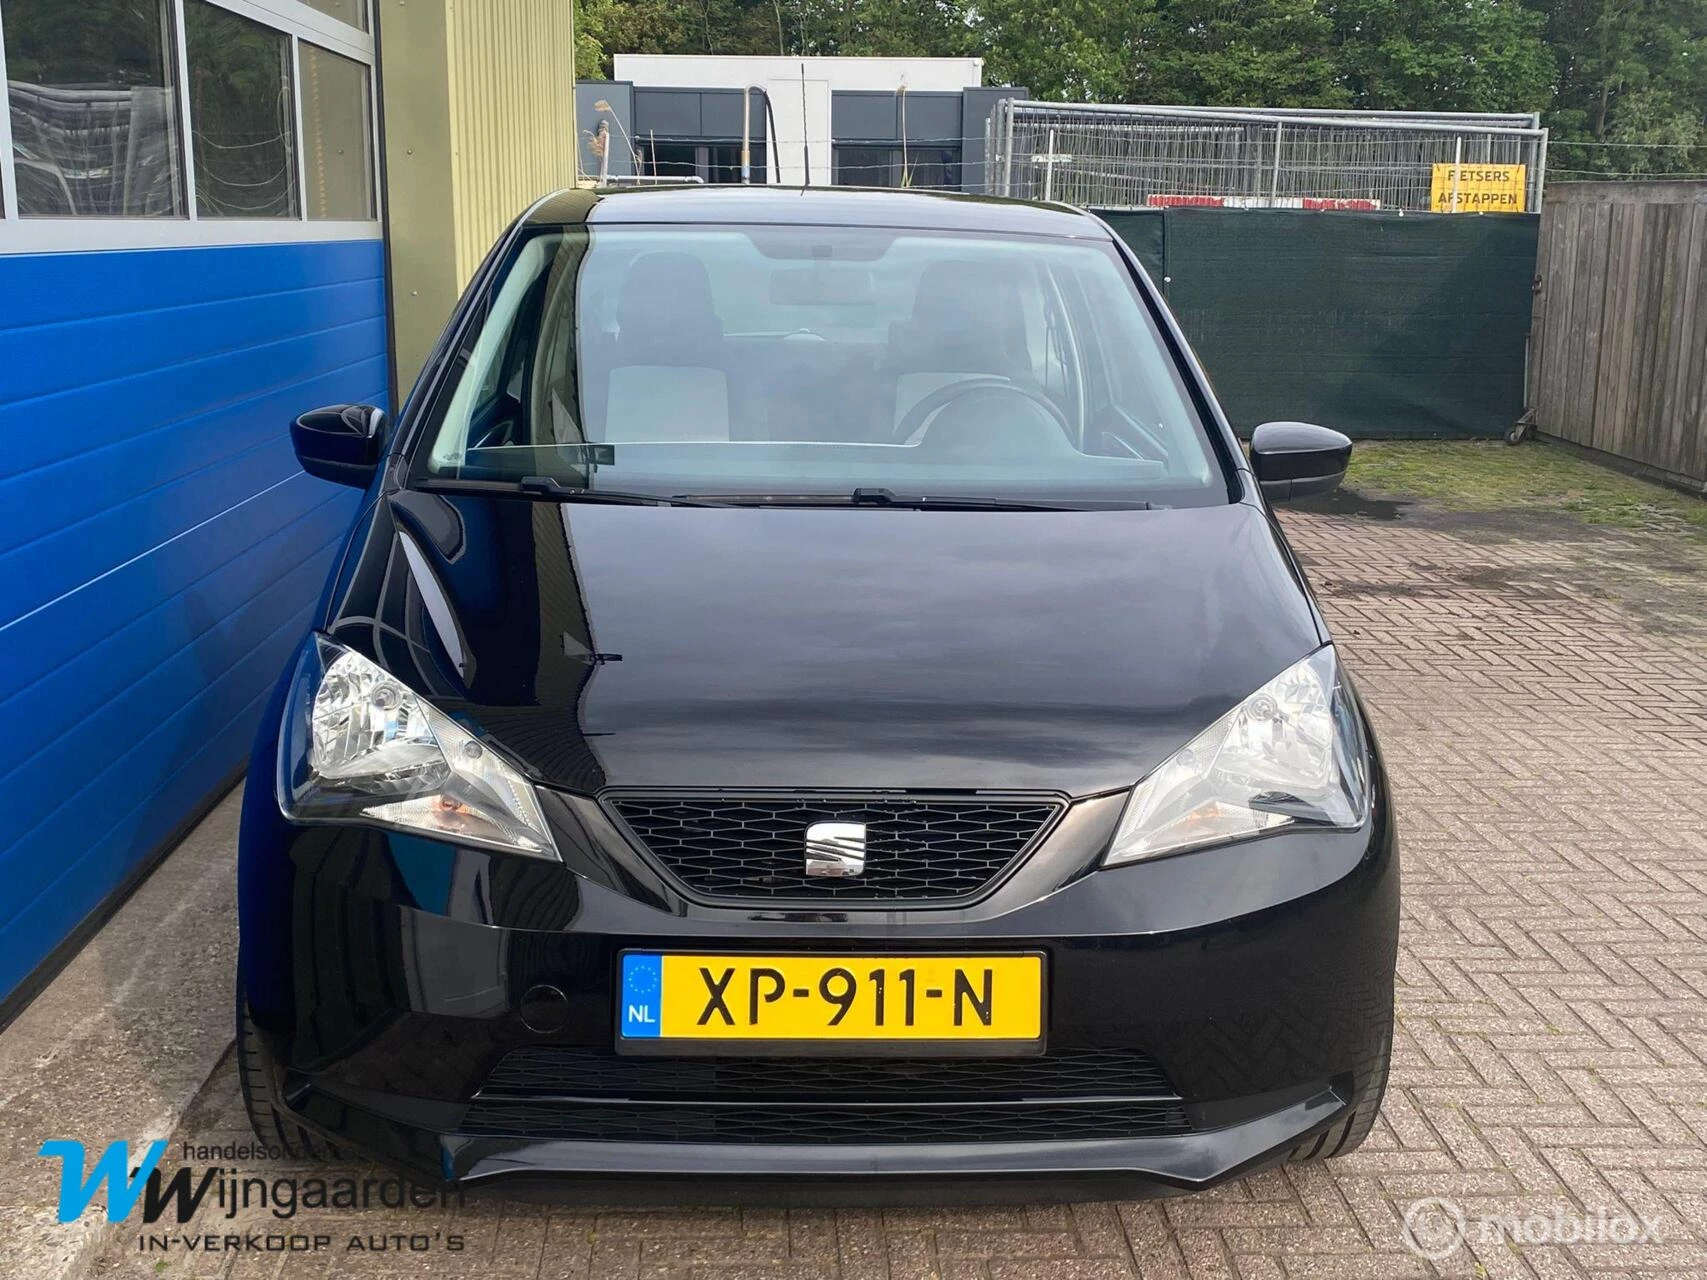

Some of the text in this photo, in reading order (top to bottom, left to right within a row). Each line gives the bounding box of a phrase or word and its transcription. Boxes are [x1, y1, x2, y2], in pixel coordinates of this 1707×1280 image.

[1447, 170, 1510, 182] FETSERS
[696, 967, 993, 1027] XP-911-N
[628, 1005, 656, 1024] NL
